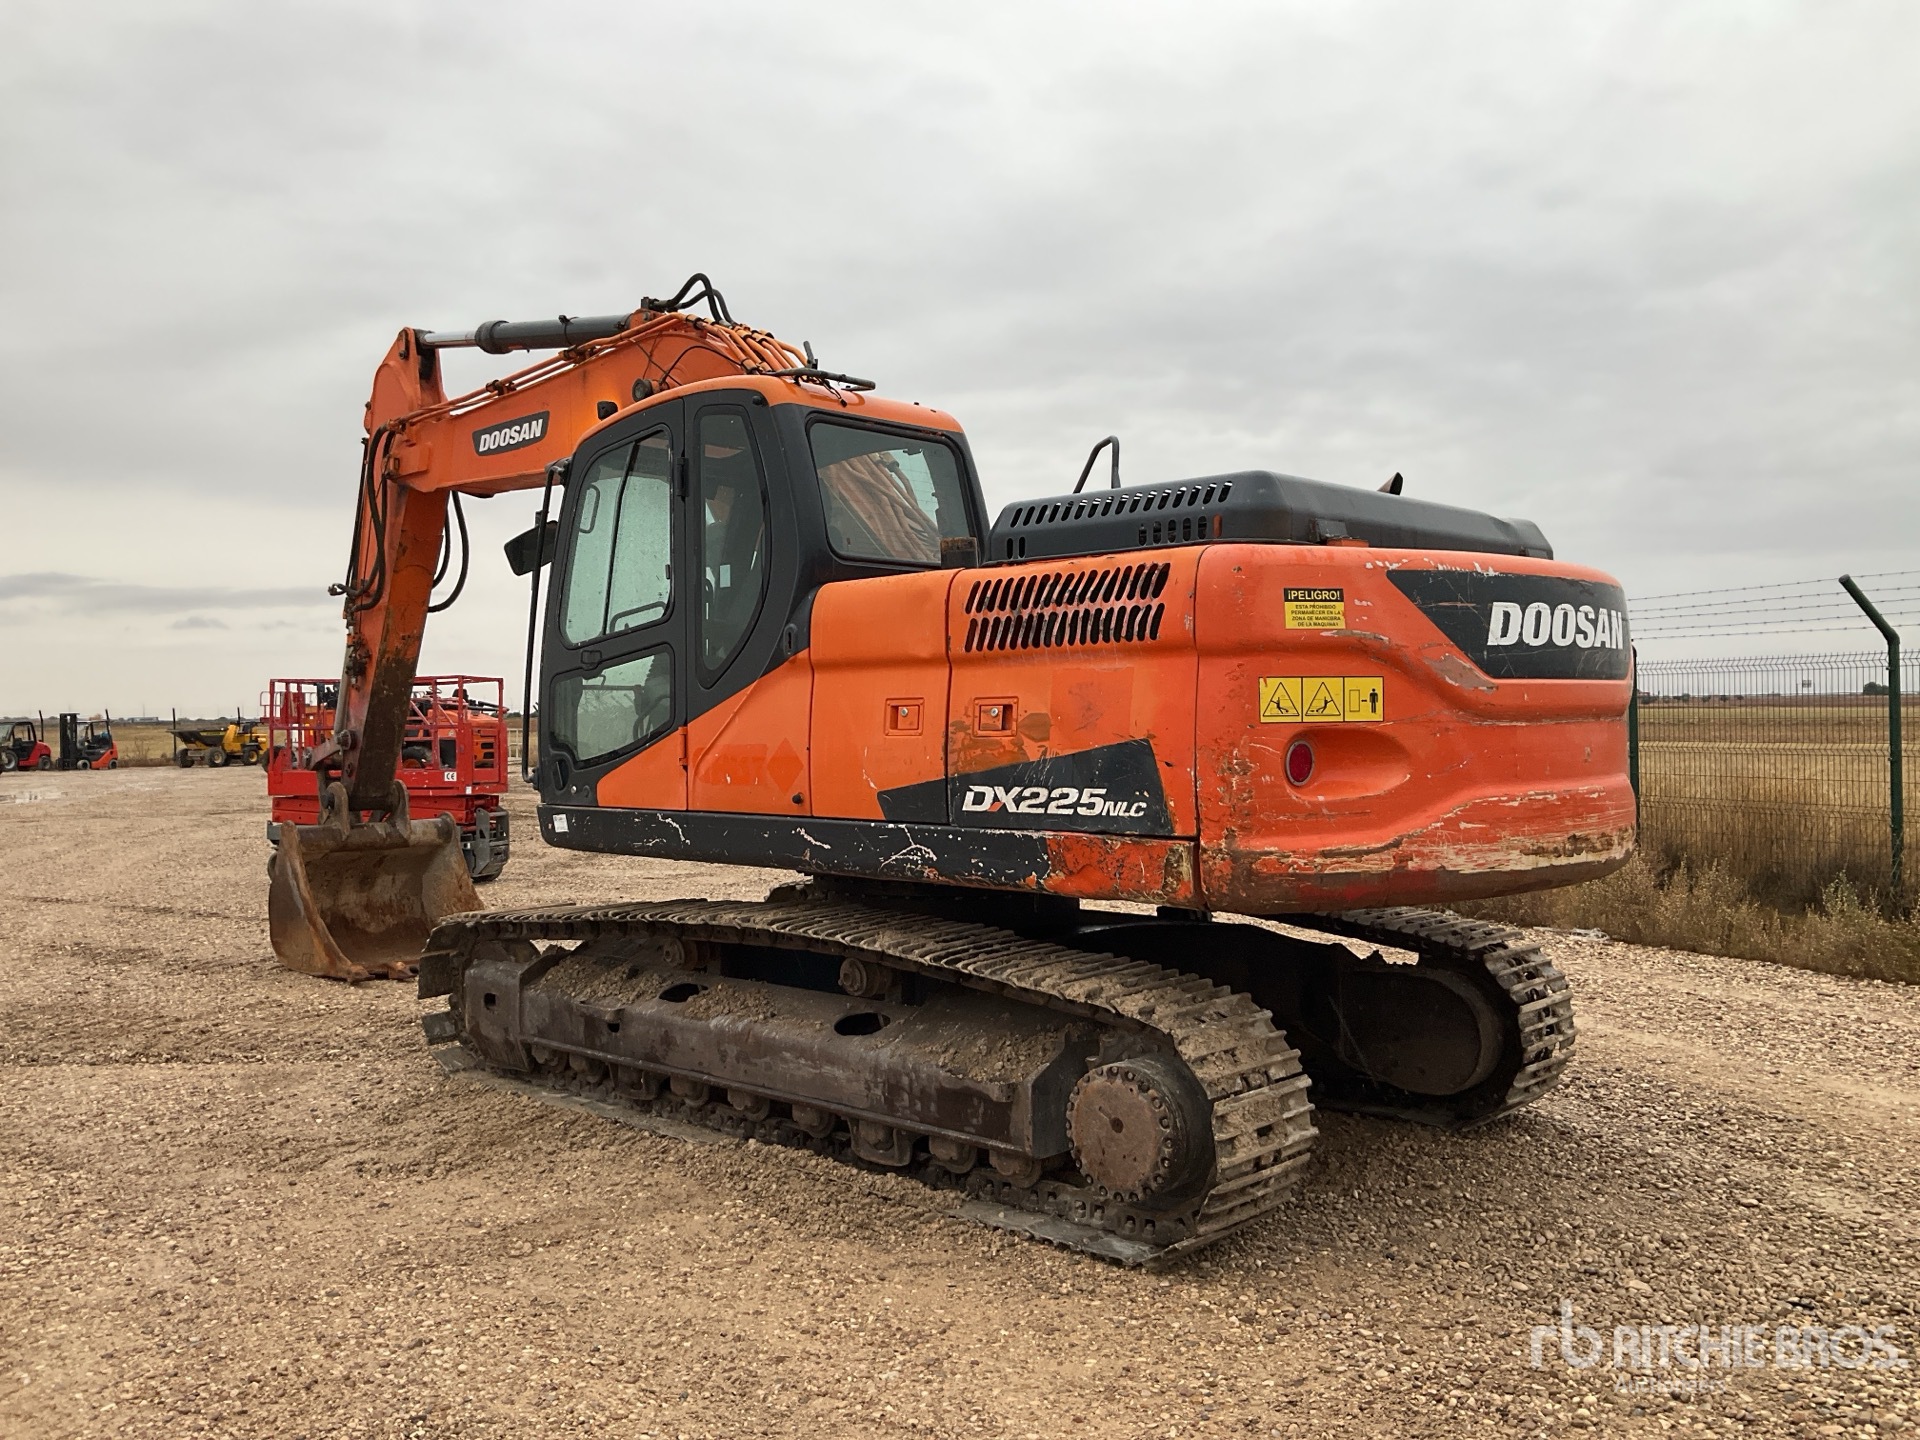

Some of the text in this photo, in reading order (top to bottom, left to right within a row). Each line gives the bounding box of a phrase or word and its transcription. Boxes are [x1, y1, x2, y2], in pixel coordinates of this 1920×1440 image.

[479, 418, 543, 452] DOOSAN
[1288, 590, 1341, 600] ¡PELIGRO!
[1487, 601, 1623, 649] DOOSAN
